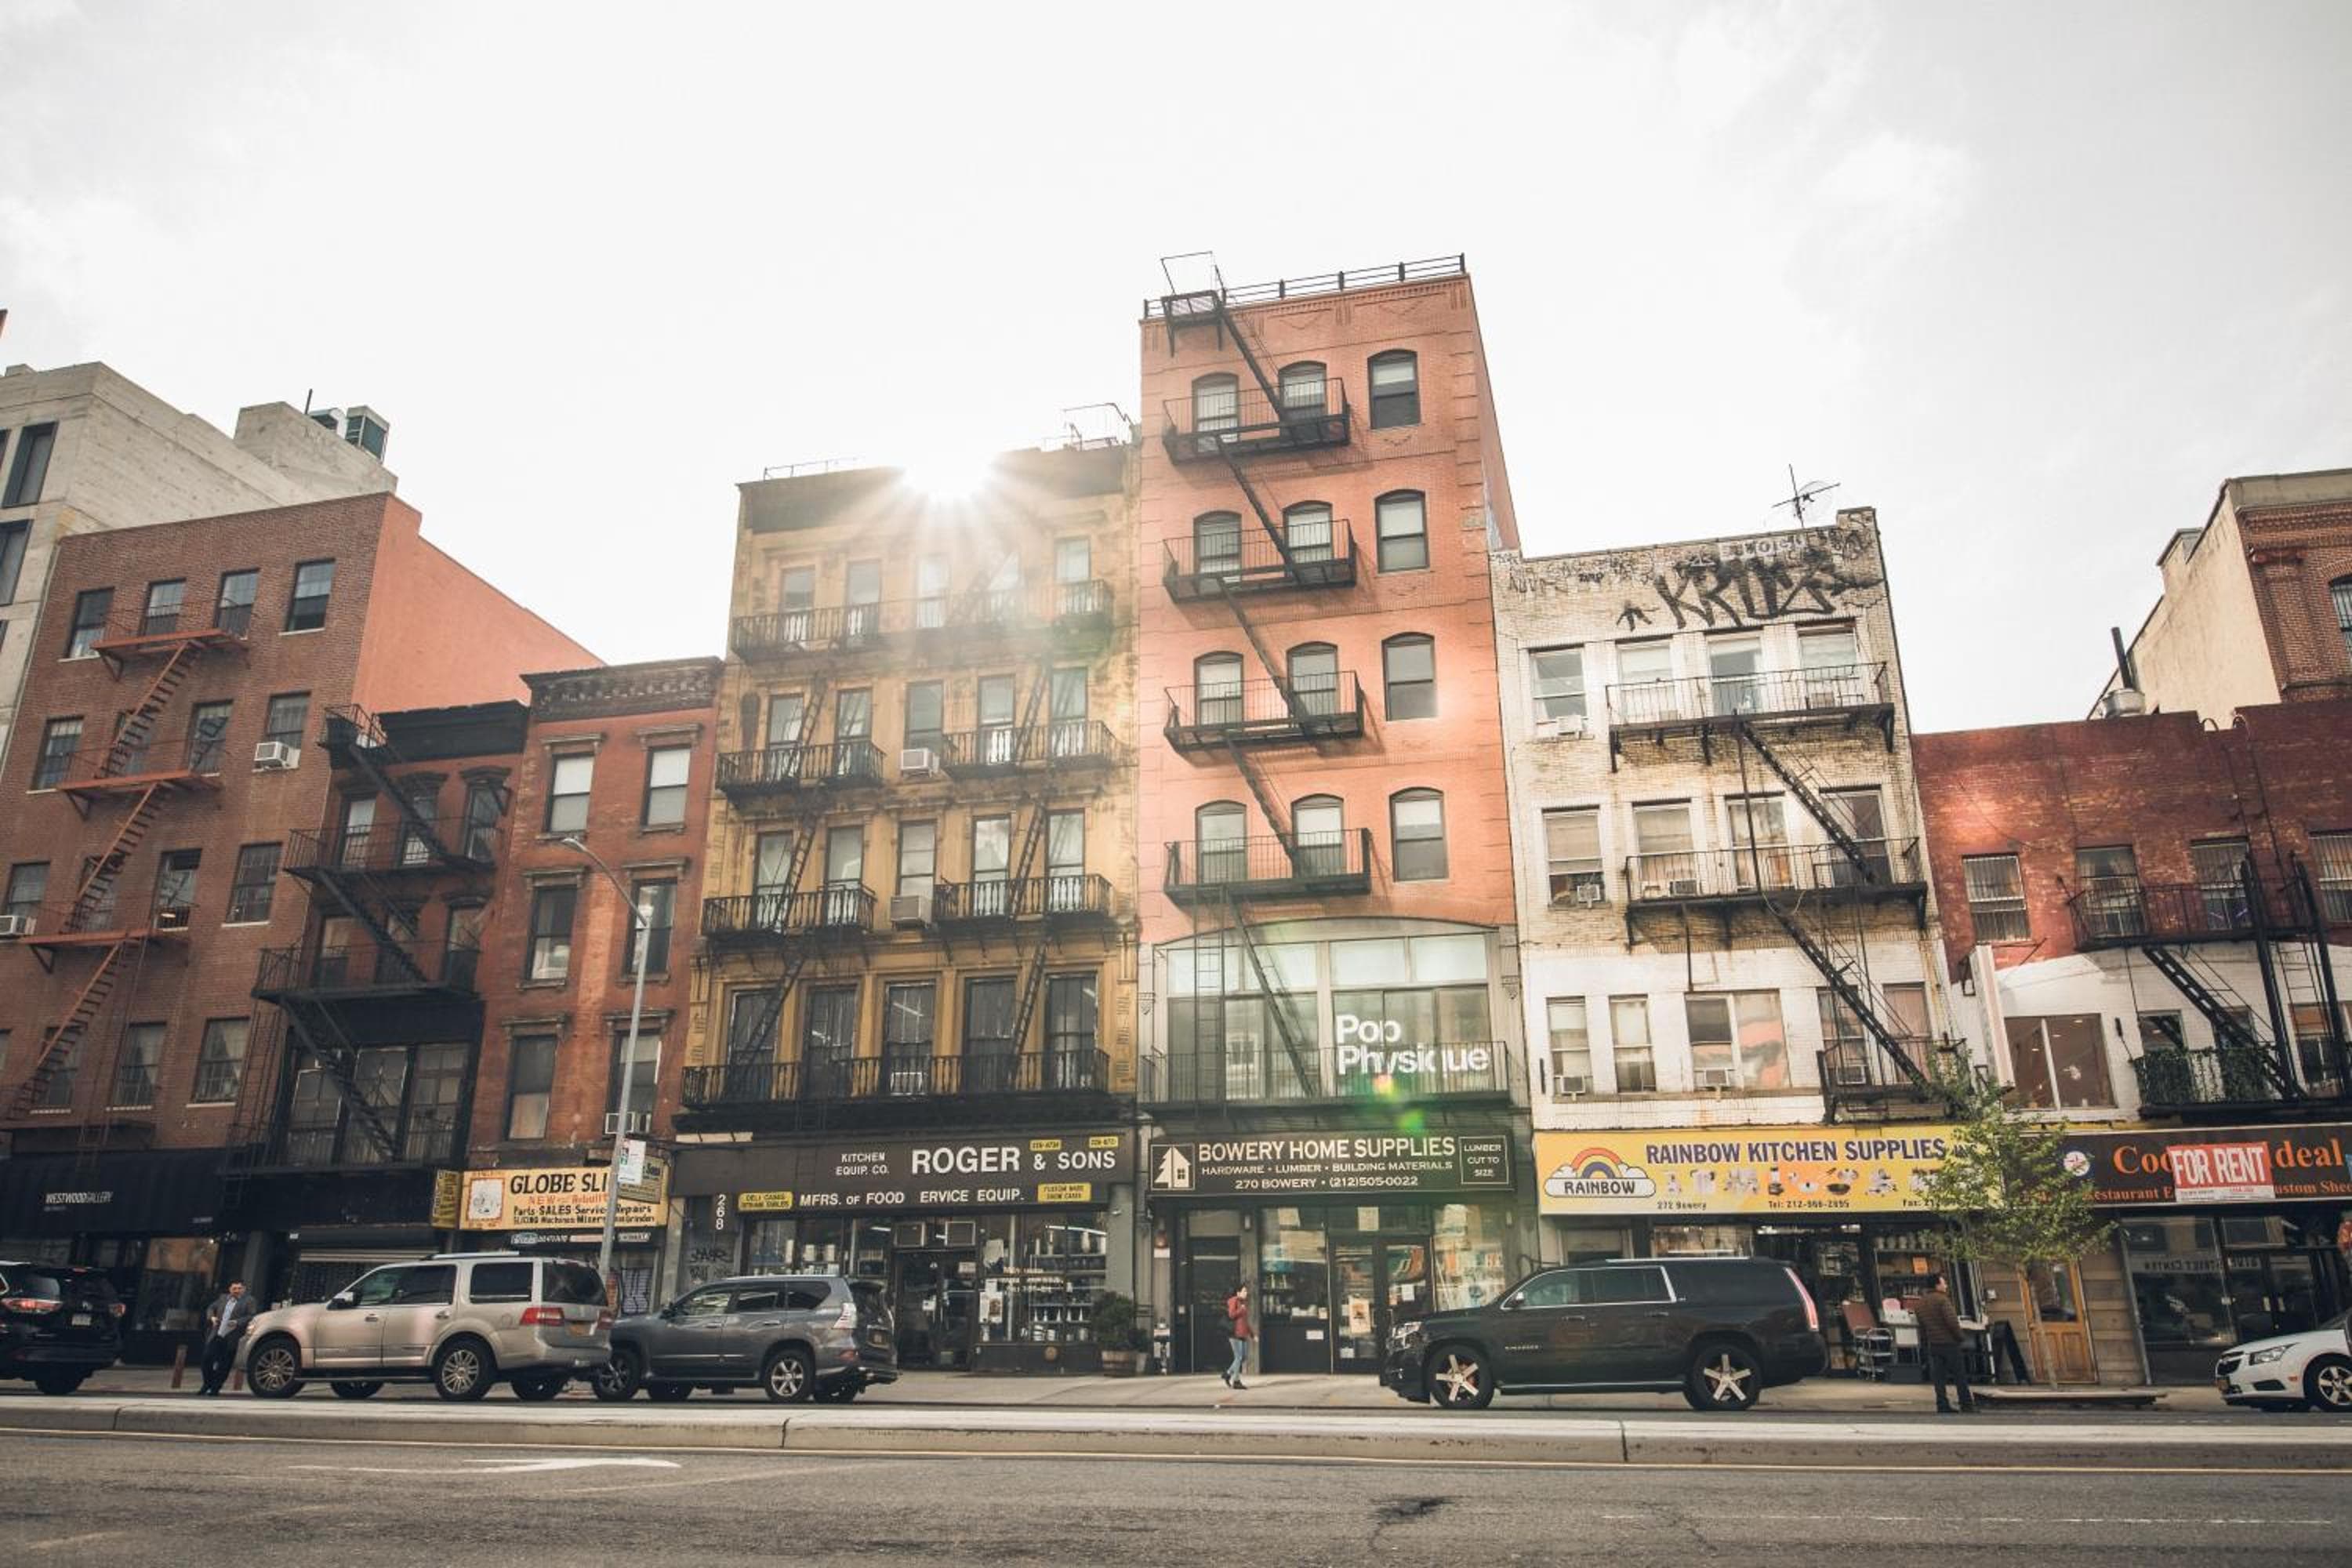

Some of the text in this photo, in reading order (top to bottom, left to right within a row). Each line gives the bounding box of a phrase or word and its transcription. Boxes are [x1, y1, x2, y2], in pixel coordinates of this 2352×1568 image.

[1336, 1014, 1401, 1046] Pop
[1338, 1043, 1490, 1078] Physique
[1199, 1137, 1456, 1162] BOWERY HOME SUPPLIES
[1464, 1144, 1501, 1152] LUMBER
[1646, 1143, 1740, 1164] RAINBOW
[1748, 1141, 1838, 1162] KITCHEN
[1845, 1138, 1945, 1160] SUPPLIES
[841, 1152, 885, 1163] KITCHEN
[912, 1147, 1116, 1174] ROGER & SONS
[2113, 1145, 2172, 1174] Coo
[836, 1165, 890, 1176] EQUIP. CO.
[1202, 1161, 1453, 1175] HARDWARE LUMBER BUILDING MATERIALS
[2170, 1147, 2267, 1185] FOR RENT
[510, 1174, 576, 1194] GLOBE
[581, 1172, 608, 1192] SLI
[1235, 1178, 1258, 1189] 270
[1262, 1178, 1317, 1189] BOWERY
[1564, 1181, 1635, 1195] RAINBOW
[2274, 1184, 2317, 1193] ustom
[2320, 1179, 2352, 1192] Shee
[800, 1194, 841, 1207] MFRS.
[866, 1192, 905, 1204] FOOD
[920, 1189, 968, 1203] ERVICE
[977, 1189, 1024, 1202] EQUIP.
[1657, 1201, 1673, 1210] 272
[514, 1205, 535, 1216] Parts
[539, 1204, 572, 1215] SALES
